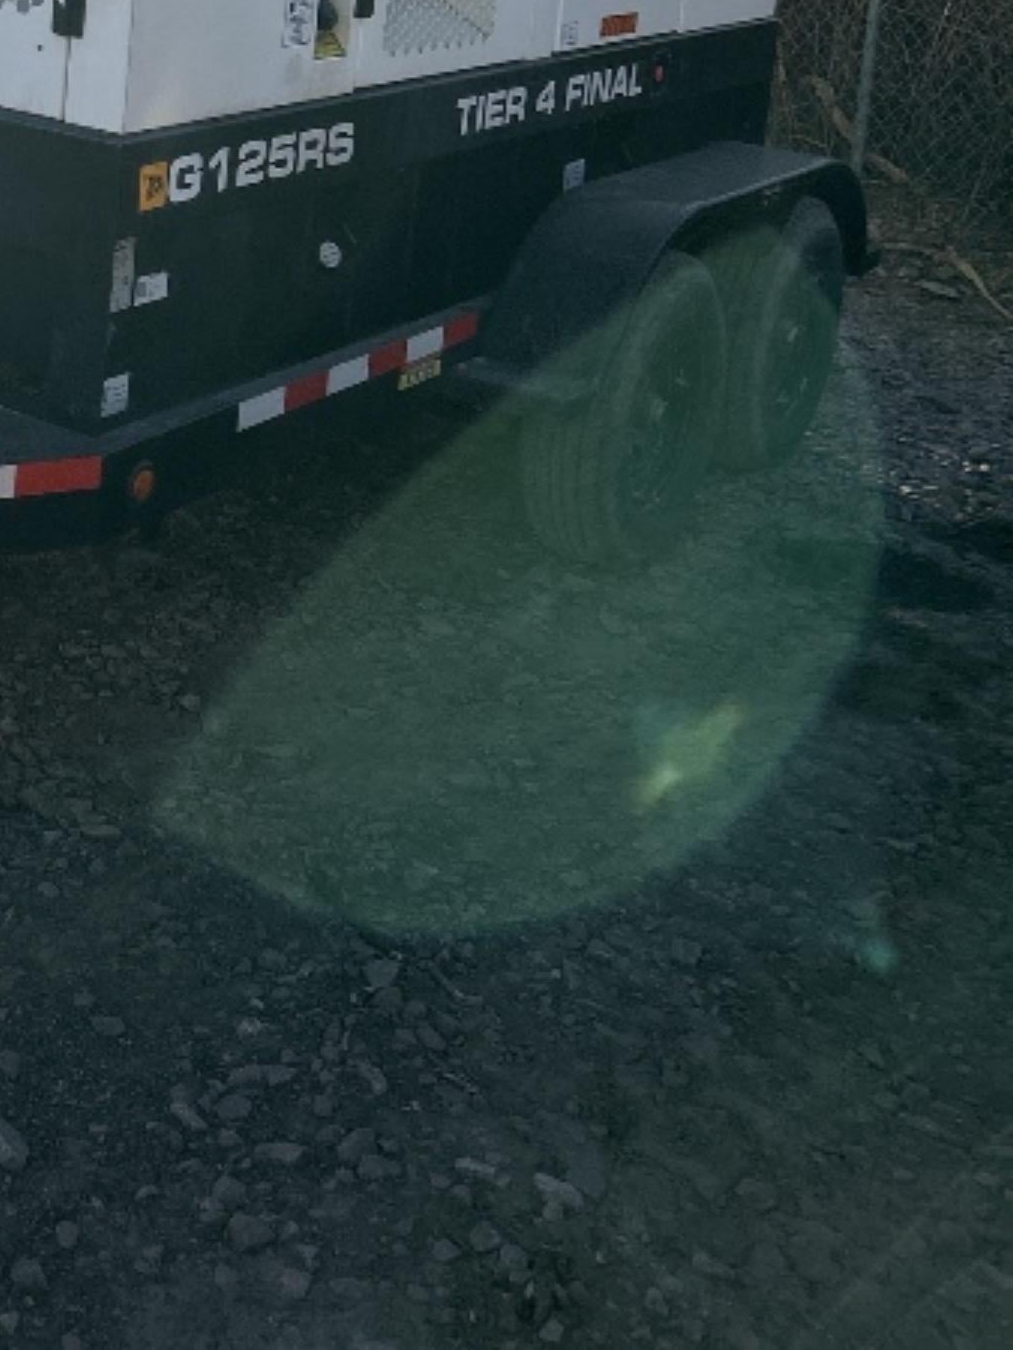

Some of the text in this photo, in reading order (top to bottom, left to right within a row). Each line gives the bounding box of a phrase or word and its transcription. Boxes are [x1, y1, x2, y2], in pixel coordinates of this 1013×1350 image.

[457, 63, 643, 136] TIER 4 FINAL
[169, 122, 355, 203] G125RS
